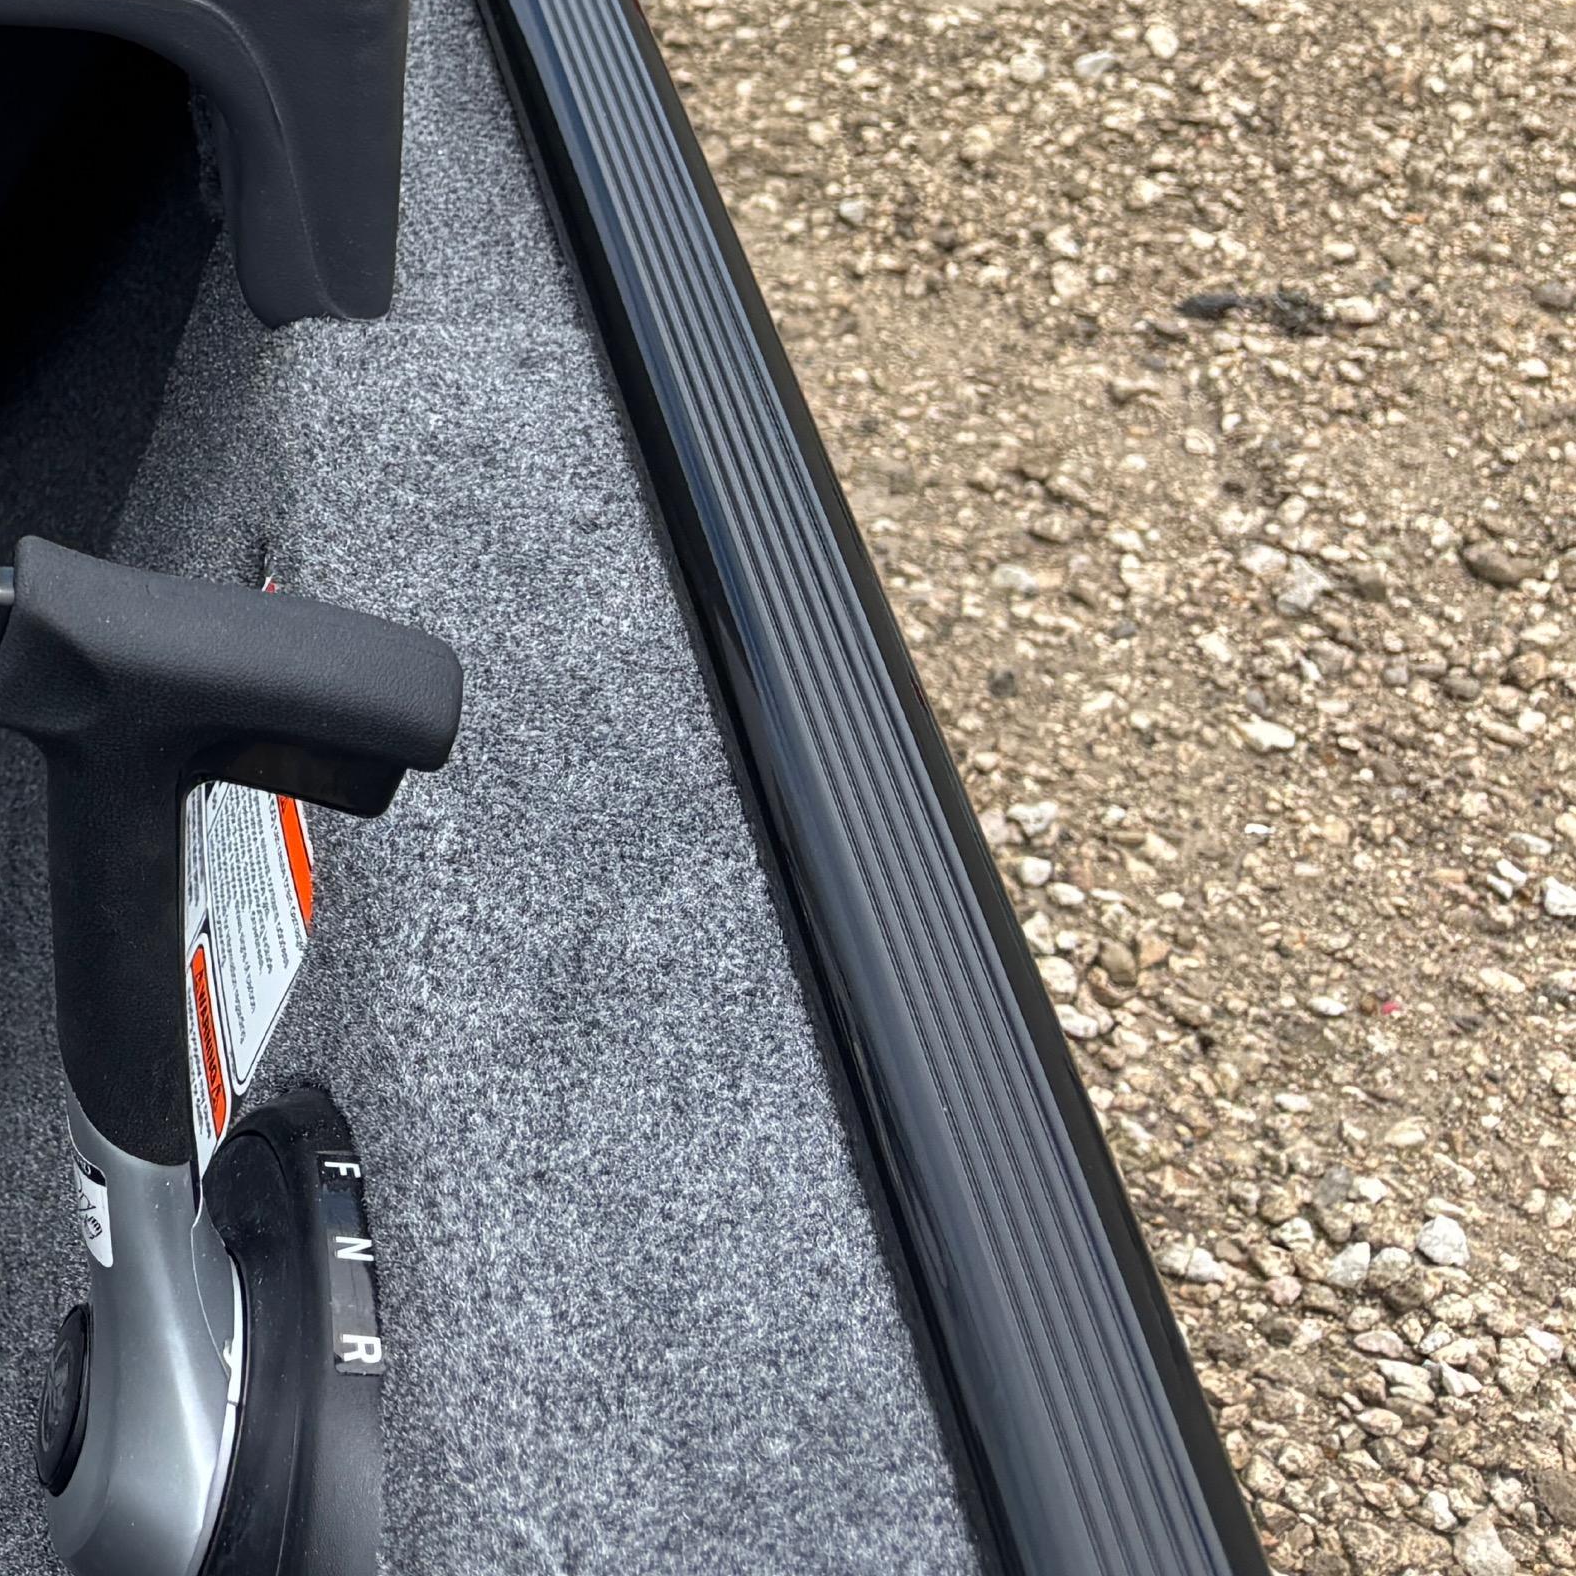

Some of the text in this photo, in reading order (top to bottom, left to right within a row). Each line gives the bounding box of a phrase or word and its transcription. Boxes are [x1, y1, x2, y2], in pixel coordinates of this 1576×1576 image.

[324, 1161, 362, 1179] F
[334, 1235, 375, 1262] N
[341, 1333, 383, 1364] R
